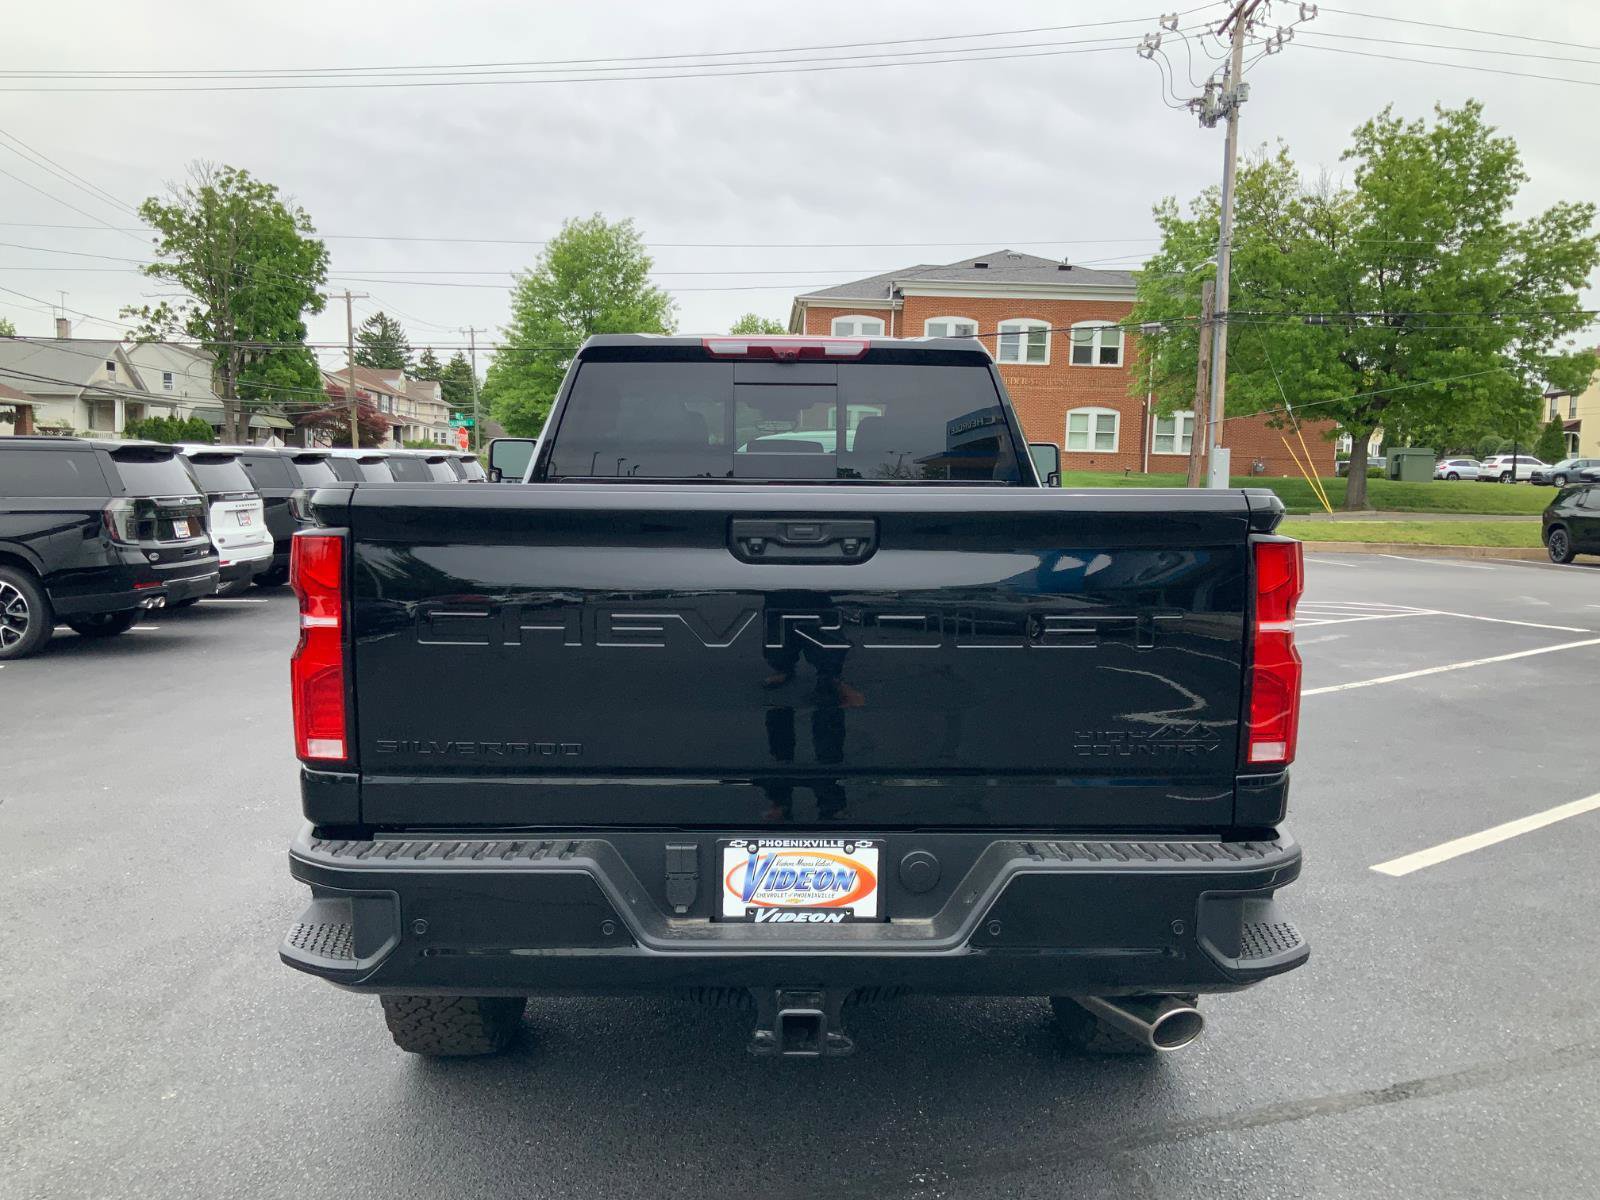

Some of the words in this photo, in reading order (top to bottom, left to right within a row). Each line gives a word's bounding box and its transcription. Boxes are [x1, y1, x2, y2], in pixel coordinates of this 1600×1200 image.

[414, 607, 1185, 648] CHEVROLET
[1073, 731, 1148, 743] HIGH
[375, 738, 584, 757] SILVERADO
[1073, 744, 1220, 757] COUNTRY
[757, 840, 845, 848] PHOENIXVILLE
